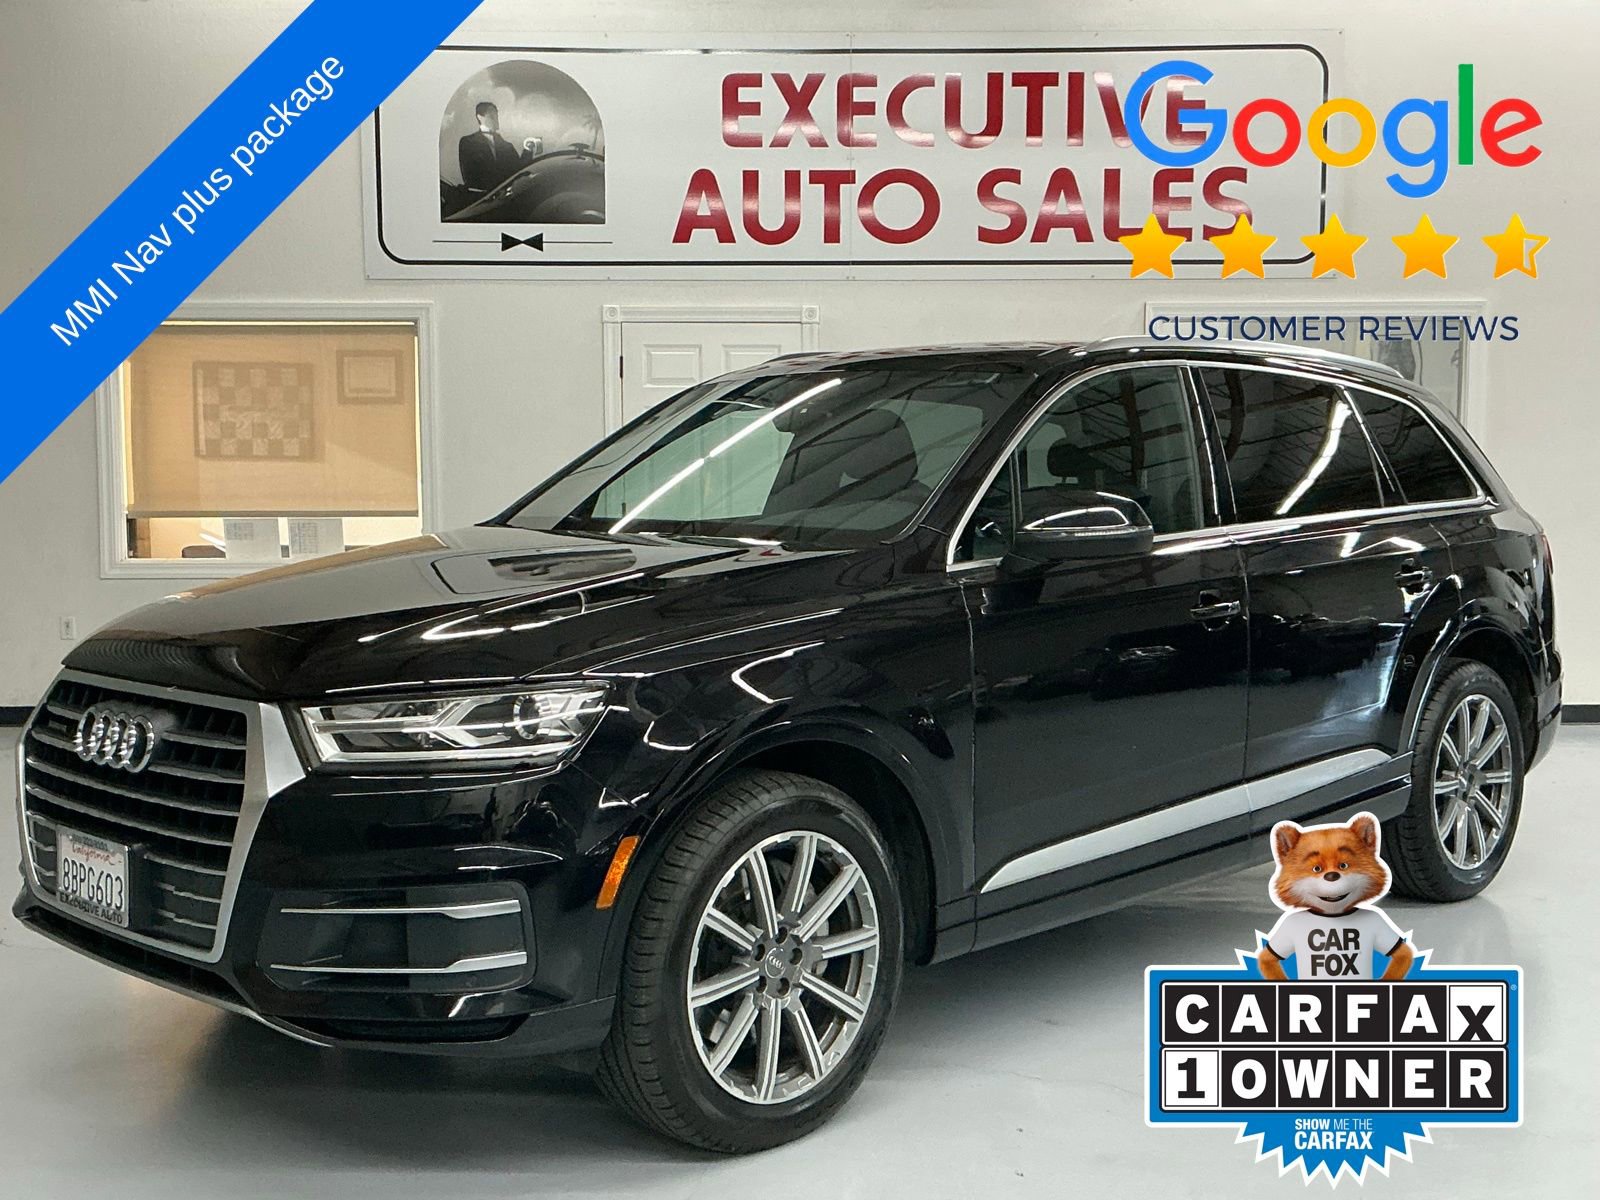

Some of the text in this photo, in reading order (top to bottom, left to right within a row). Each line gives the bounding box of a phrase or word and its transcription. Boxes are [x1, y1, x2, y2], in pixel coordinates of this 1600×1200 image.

[672, 166, 1253, 245] AUTO SALES
[63, 857, 123, 911] 8BPG603
[101, 907, 123, 925] AUTO
